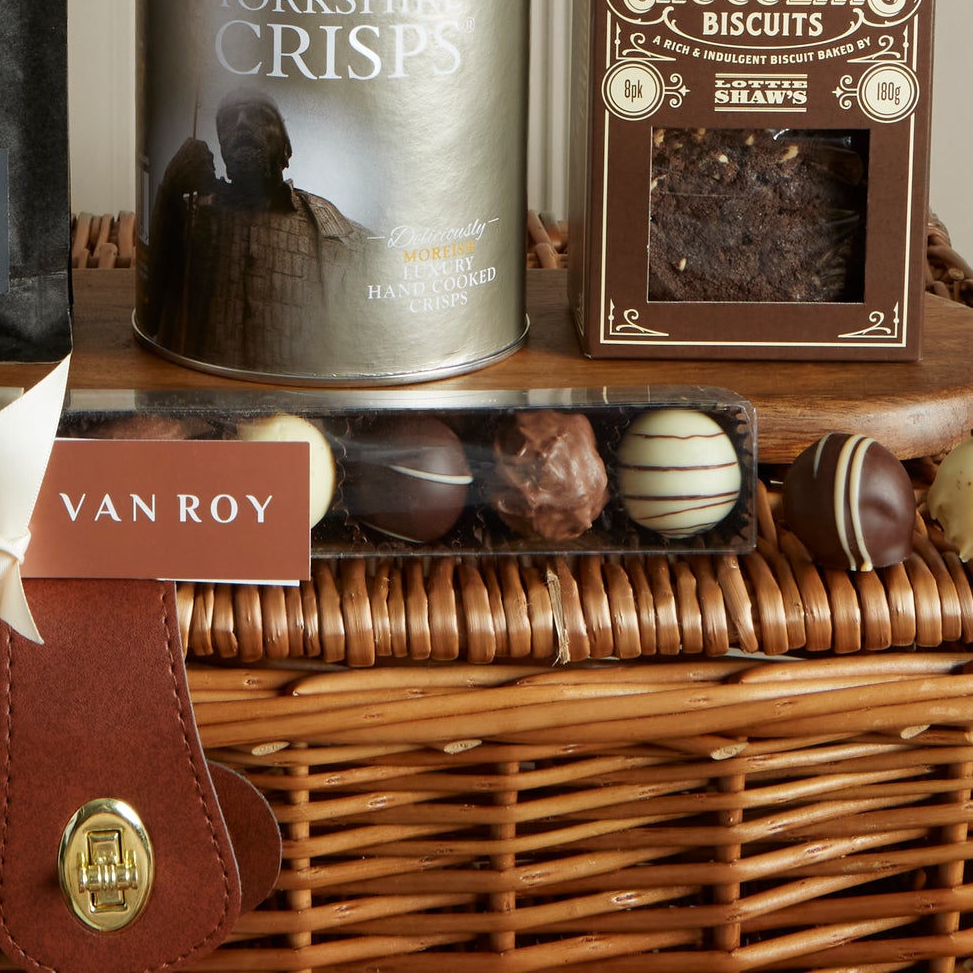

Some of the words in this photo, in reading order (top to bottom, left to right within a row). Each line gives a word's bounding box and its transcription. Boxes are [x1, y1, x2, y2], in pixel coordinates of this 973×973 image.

[702, 11, 824, 37] BISCUITS
[652, 35, 662, 46] A
[663, 41, 690, 55] RICH
[692, 48, 701, 58] &
[703, 51, 768, 65] INDULGENT
[770, 51, 815, 65] BISCUIT
[817, 41, 855, 60] BAKED
[856, 36, 872, 50] BY
[624, 80, 644, 104] 8pk
[714, 80, 808, 89] LOTTIE
[877, 82, 902, 105] 180g
[714, 89, 808, 105] SHAW'S
[387, 219, 487, 248] Deliciously
[403, 241, 476, 263] MOREISH
[402, 256, 475, 280] LUXURY
[367, 282, 426, 300] HAND
[431, 266, 497, 294] COOKED
[409, 291, 468, 313] CRISPS
[59, 492, 158, 521] VAN
[177, 493, 274, 523] ROY
